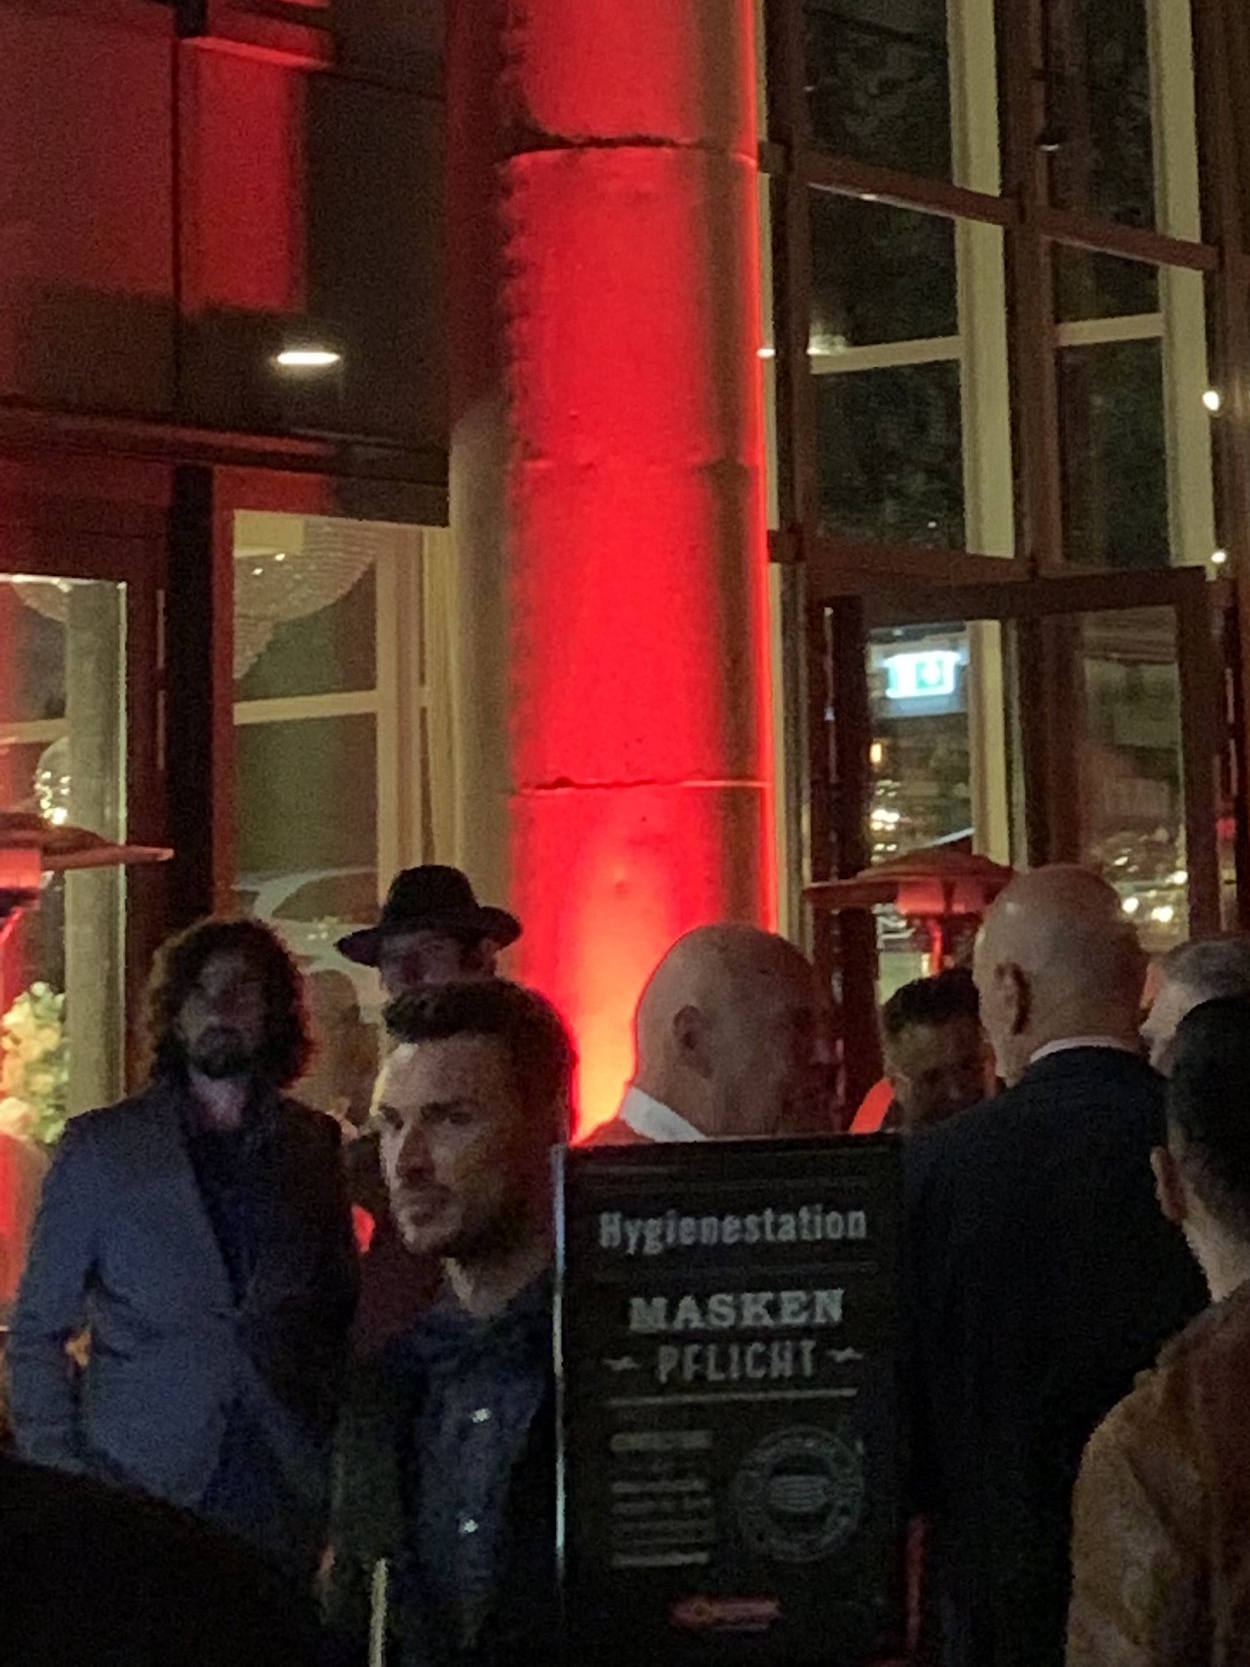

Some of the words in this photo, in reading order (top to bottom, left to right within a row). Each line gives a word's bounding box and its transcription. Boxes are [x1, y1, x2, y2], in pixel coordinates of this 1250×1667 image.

[599, 1202, 867, 1255] Hygienestation
[629, 1288, 845, 1332] MASKEN
[657, 1338, 818, 1383] PFLICHT
